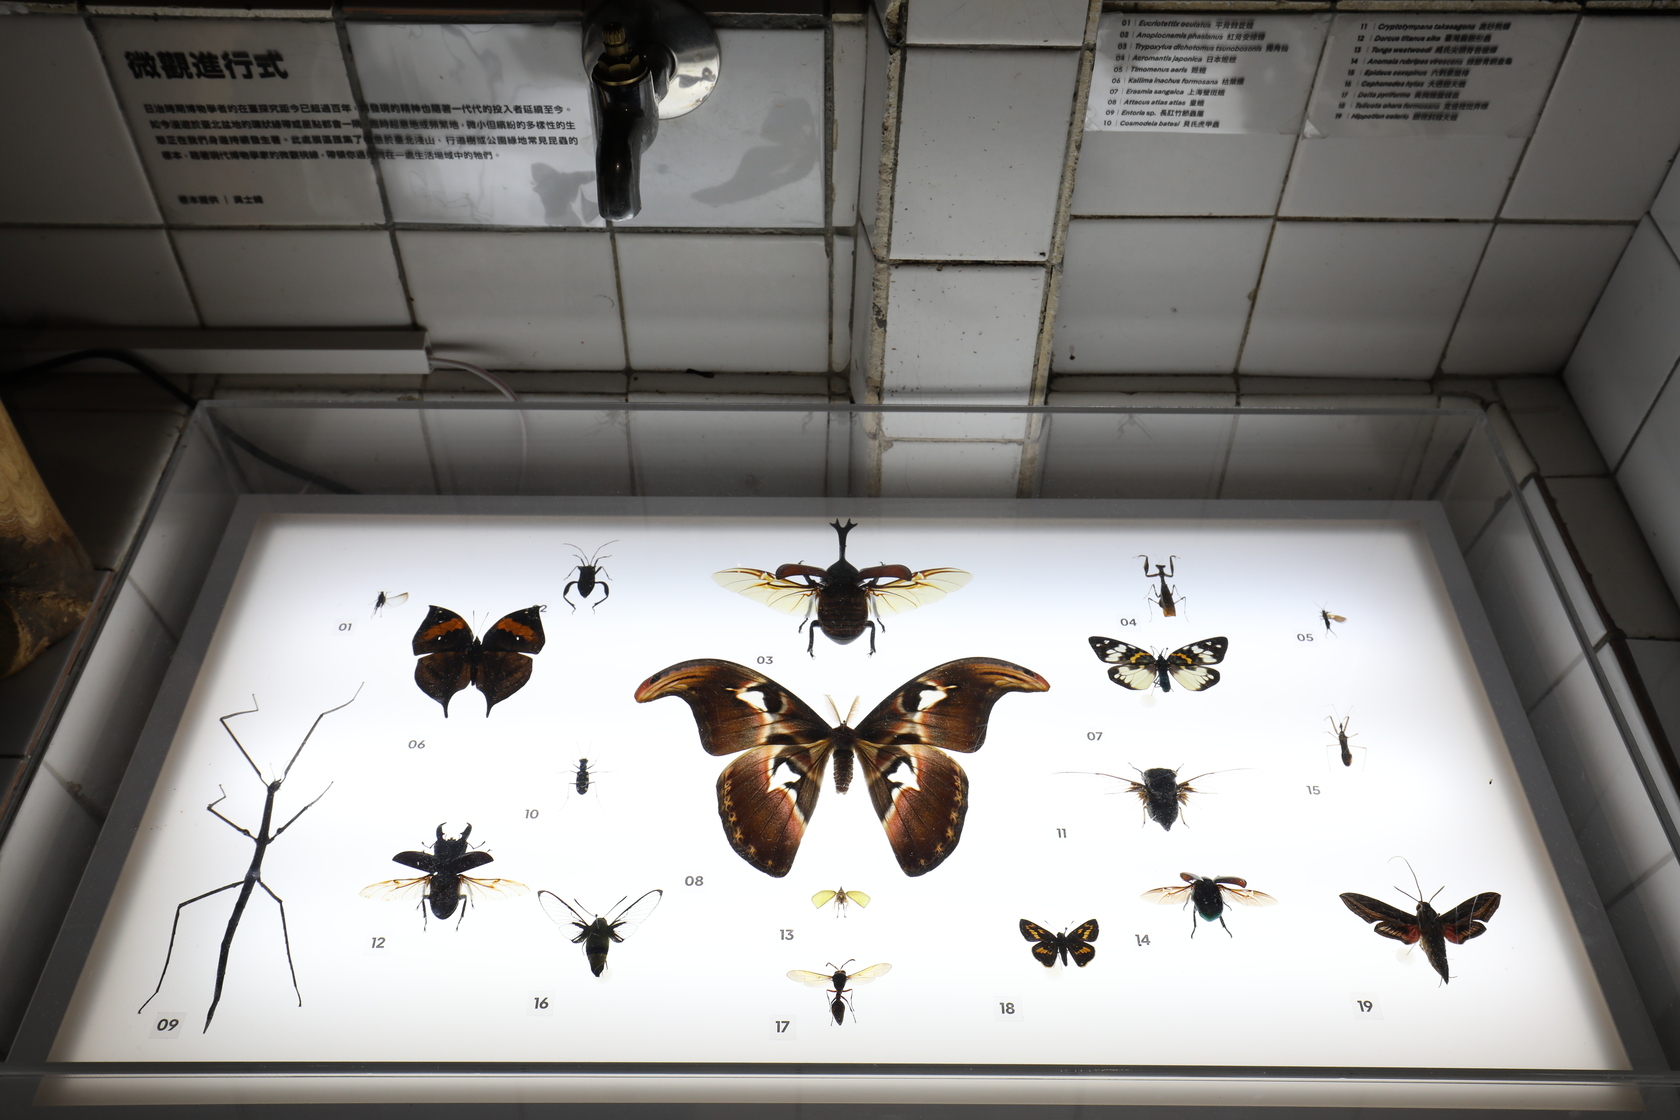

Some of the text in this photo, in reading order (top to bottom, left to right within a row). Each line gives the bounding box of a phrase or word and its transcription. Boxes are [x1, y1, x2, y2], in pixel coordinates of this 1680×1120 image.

[1378, 23, 1433, 31] Cryptotympana
[1187, 32, 1223, 40] phasianus
[1135, 43, 1172, 51] Trypoxylus
[1372, 46, 1392, 54] Tonga
[124, 50, 288, 79] 微觀進行式
[1399, 58, 1428, 66] rubripes
[338, 622, 353, 632] 01
[1120, 617, 1137, 627] 04
[1297, 633, 1314, 642] 05
[756, 656, 774, 665] 03
[1086, 732, 1103, 741] 07
[408, 739, 426, 750] 06
[1306, 785, 1321, 796] 15
[526, 809, 540, 820] 10
[1056, 828, 1067, 839] 11
[684, 876, 704, 887] 08
[779, 930, 795, 941] 13
[1135, 934, 1151, 947] 14
[371, 937, 386, 949] 12
[534, 997, 549, 1010] 16
[999, 1002, 1016, 1015] 18
[1356, 1000, 1373, 1013] 19
[156, 1018, 180, 1032] 09
[775, 1020, 790, 1033] 17
